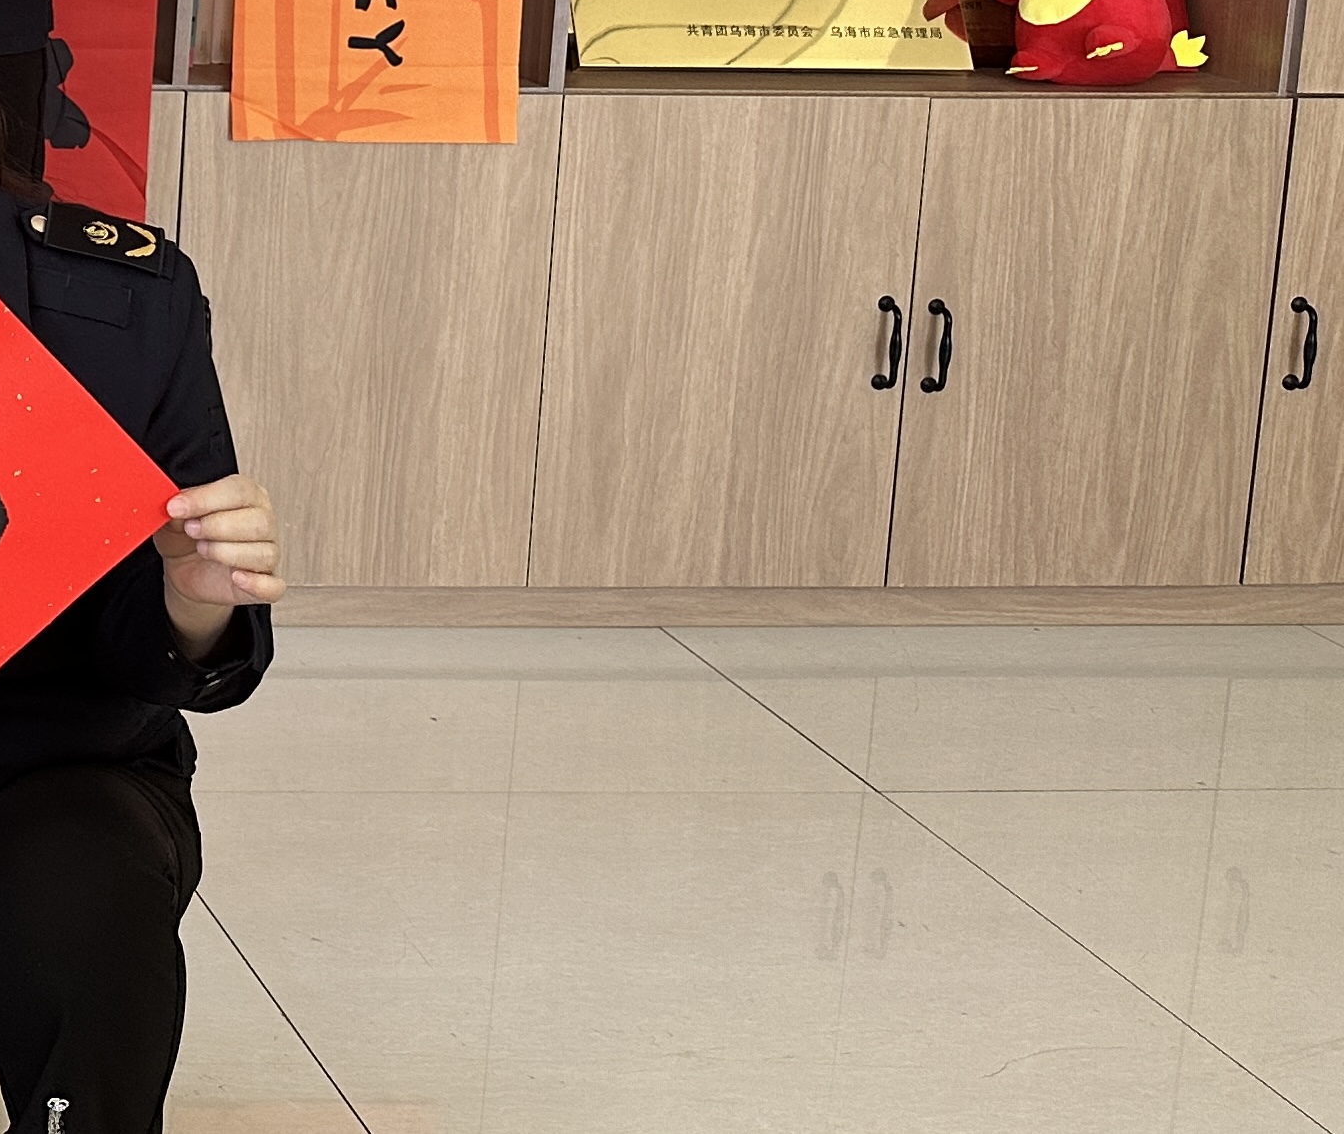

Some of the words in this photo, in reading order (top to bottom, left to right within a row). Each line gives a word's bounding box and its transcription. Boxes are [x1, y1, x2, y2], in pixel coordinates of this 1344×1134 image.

[687, 24, 814, 39] 共青团乌海市委员会
[829, 25, 944, 41] 乌海市应急管理局
